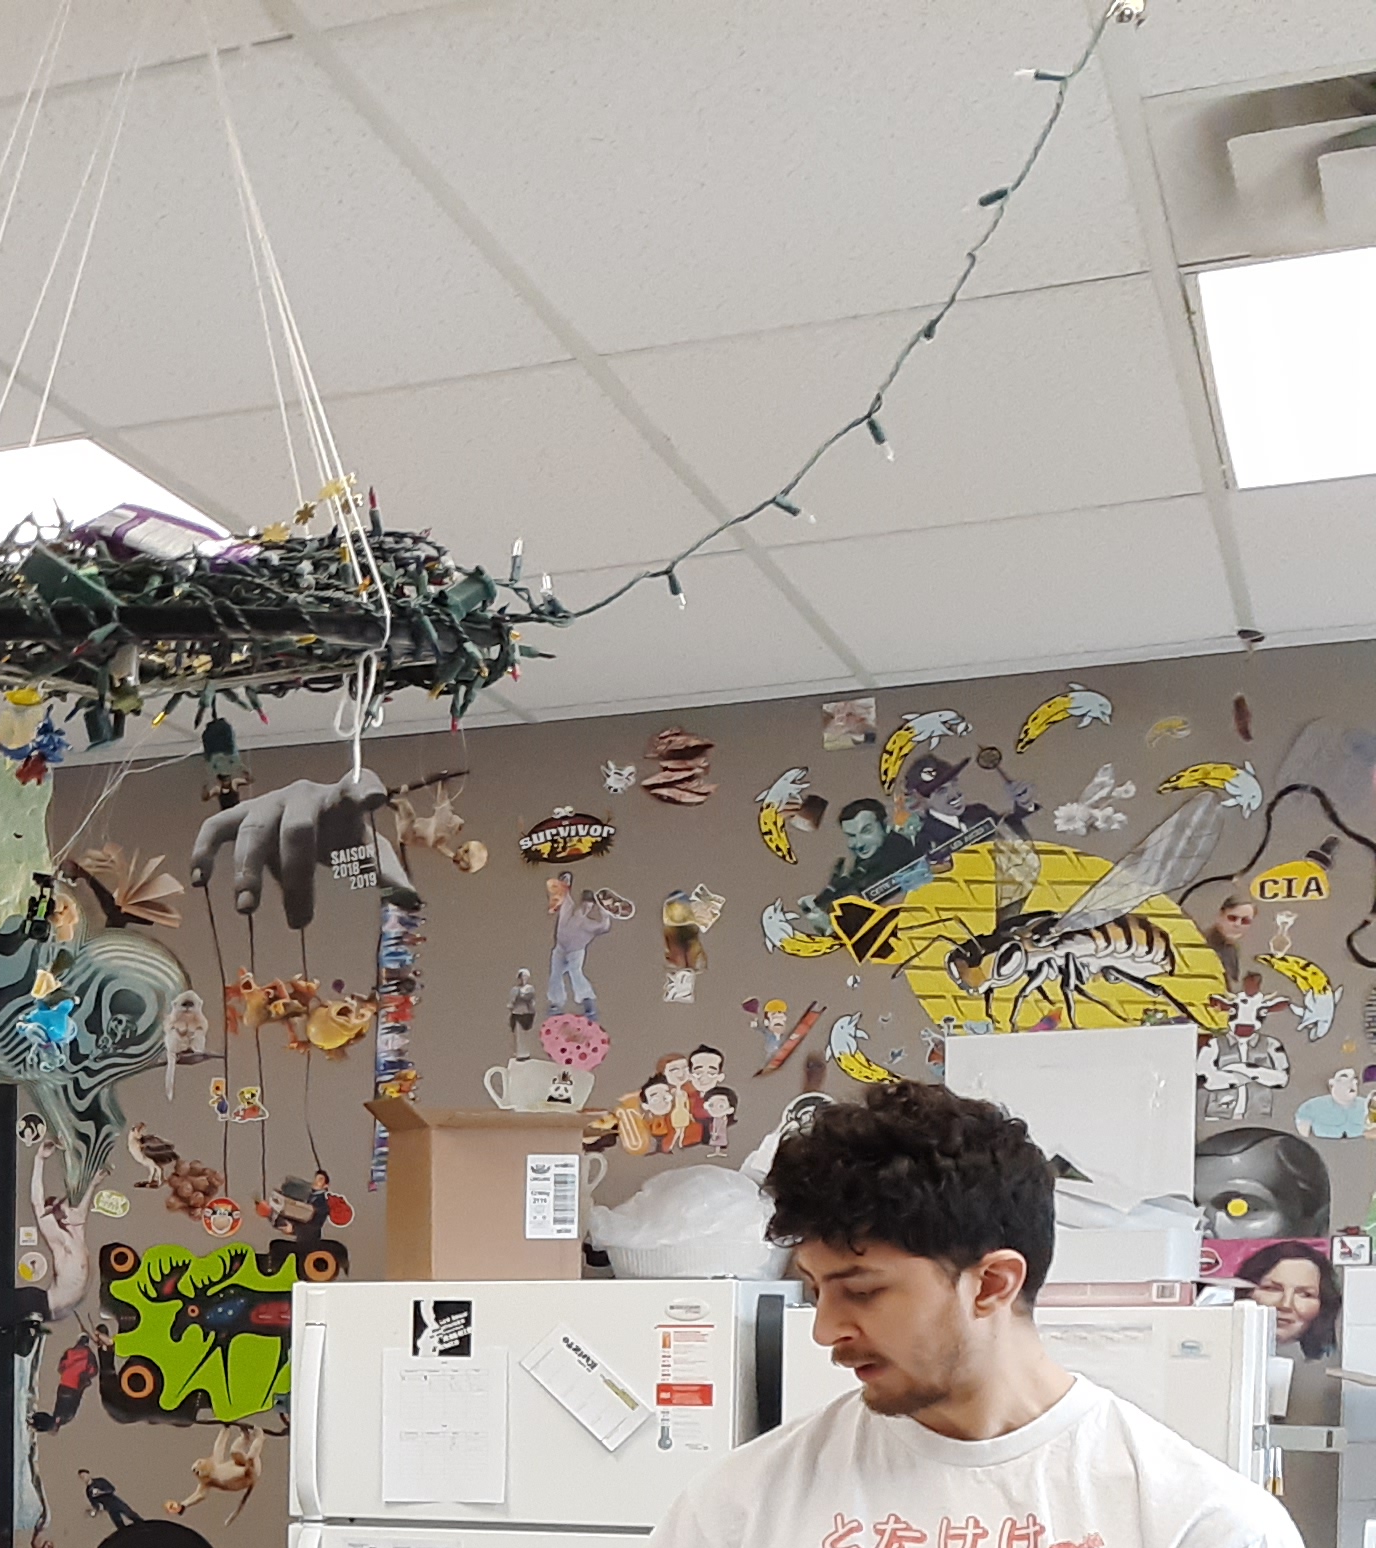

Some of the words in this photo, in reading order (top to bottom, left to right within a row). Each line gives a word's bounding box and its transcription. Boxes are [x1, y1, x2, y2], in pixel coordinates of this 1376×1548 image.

[330, 843, 376, 865] SAISON
[349, 871, 378, 890] 2019
[1259, 876, 1324, 900] CIA
